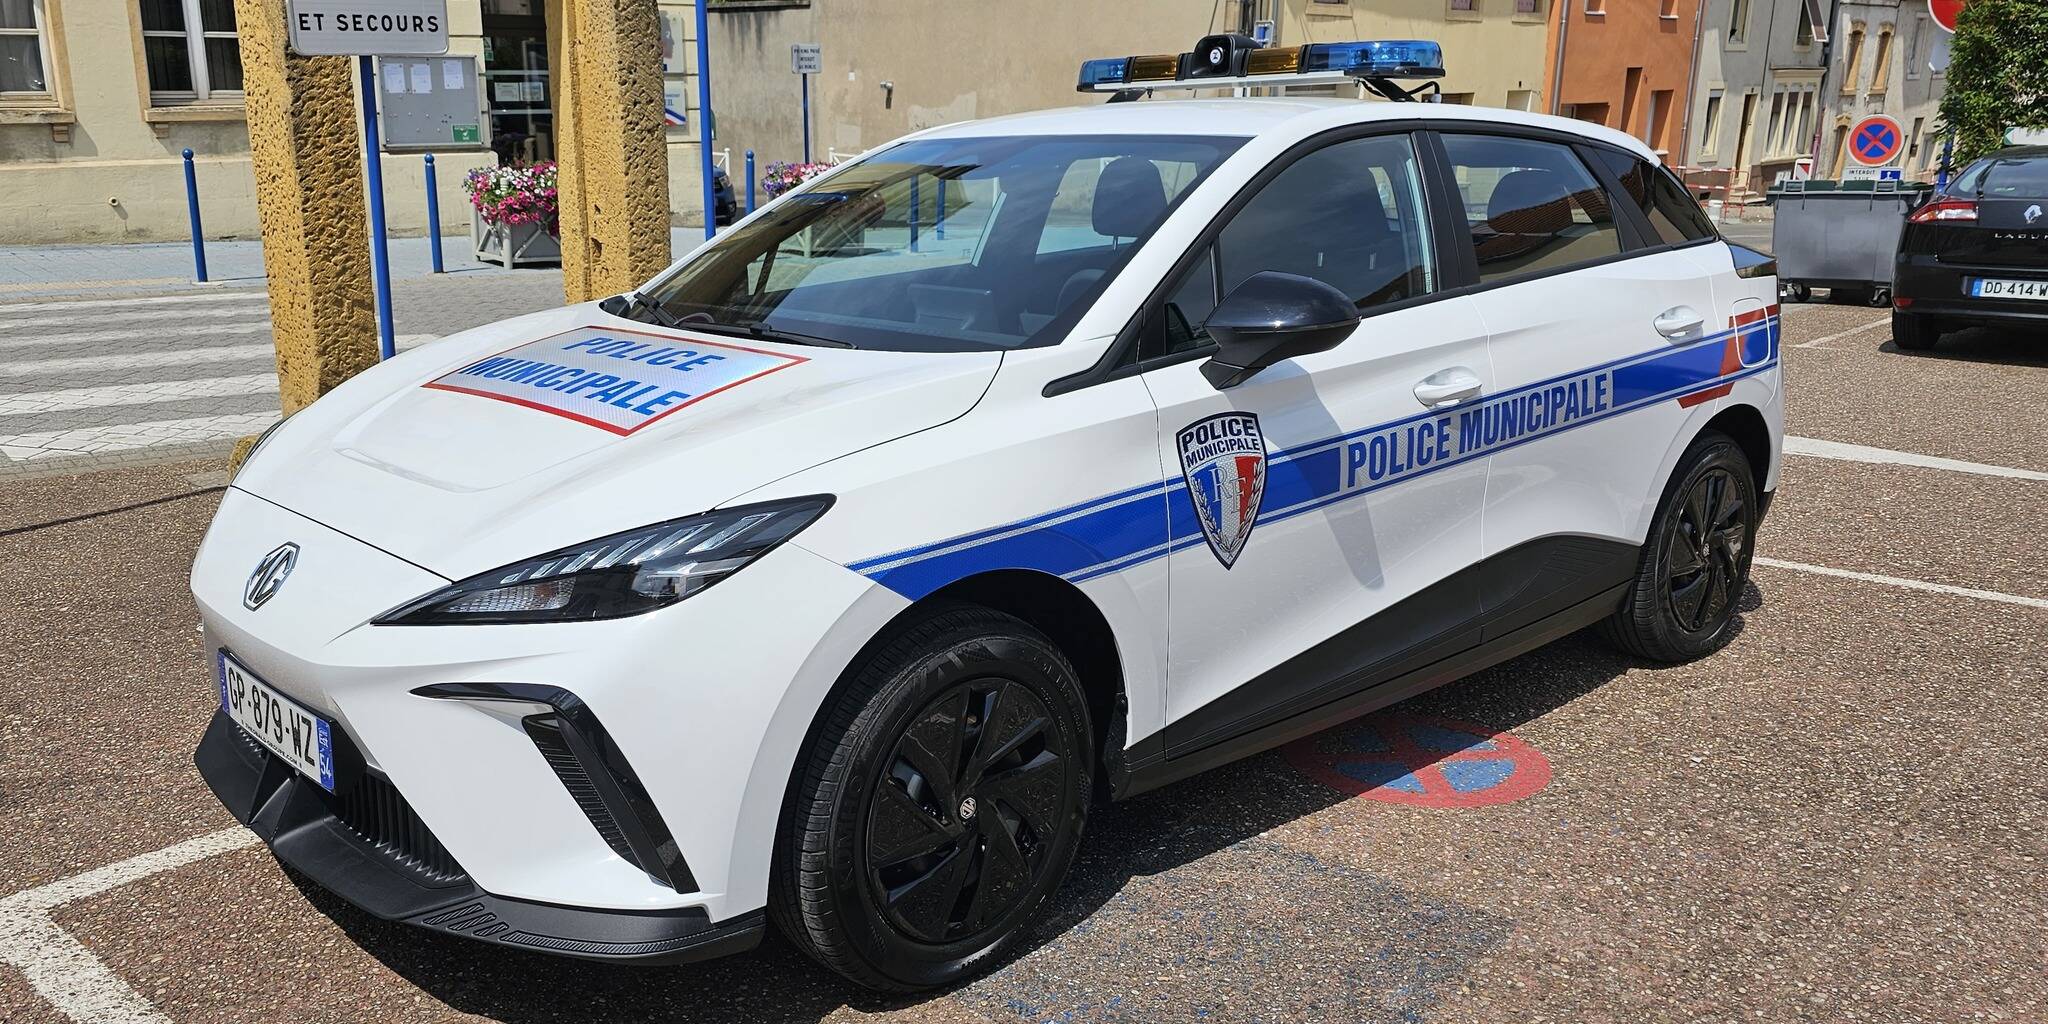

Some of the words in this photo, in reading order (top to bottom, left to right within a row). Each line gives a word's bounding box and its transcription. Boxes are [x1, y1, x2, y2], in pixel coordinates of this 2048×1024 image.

[298, 13, 324, 31] ET
[336, 14, 439, 33] SECOURS
[561, 337, 726, 372] POLICE
[456, 356, 692, 416] MUNICIPALE
[1181, 418, 1258, 453] POLICE
[1348, 416, 1452, 488] POLICE
[1458, 372, 1608, 455] MUNICIPALE
[1185, 437, 1261, 468] MUNICIPALE
[246, 545, 297, 607] MG
[228, 666, 316, 767] GP-879-WZ
[319, 752, 333, 779] 54
